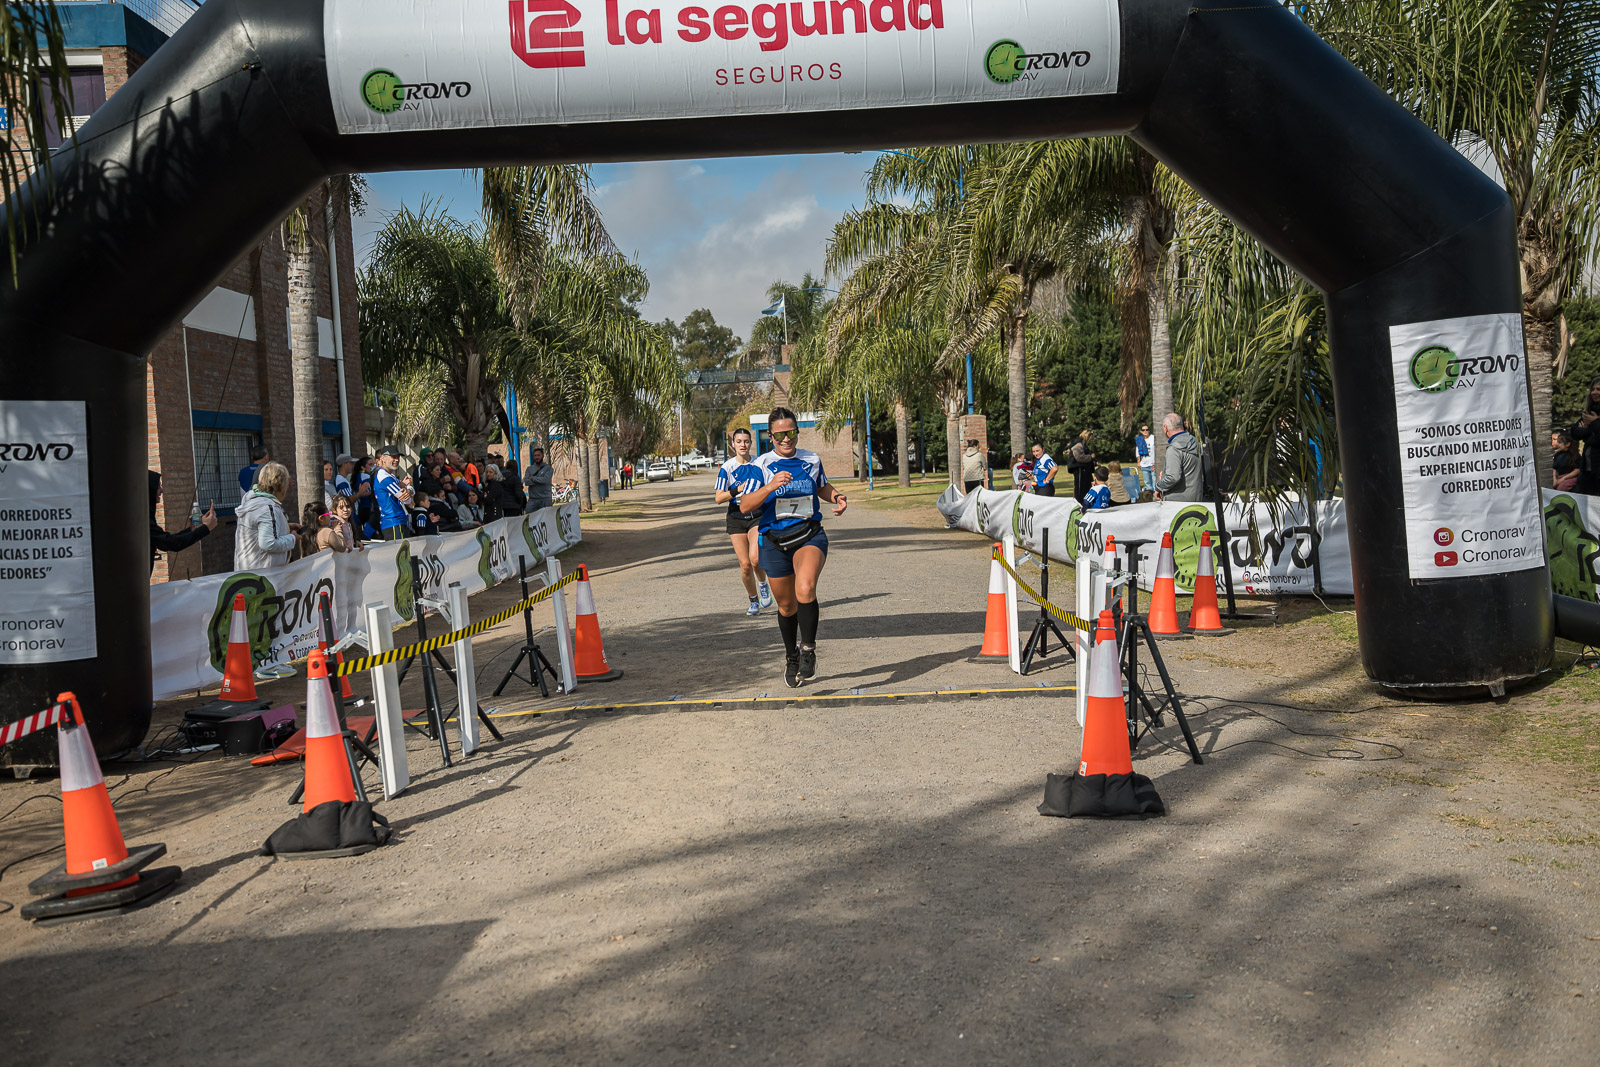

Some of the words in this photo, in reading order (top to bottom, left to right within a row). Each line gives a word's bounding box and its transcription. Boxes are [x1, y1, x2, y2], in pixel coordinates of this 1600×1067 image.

[605, 0, 662, 45] la
[677, 0, 945, 52] segunda
[1014, 50, 1091, 71] CRONO
[715, 62, 842, 86] SEGUROS
[1011, 72, 1039, 82] RAV
[392, 81, 471, 101] CRONO
[392, 102, 420, 111] RAV
[1445, 354, 1519, 377] CRONO
[1445, 378, 1476, 390] RAV
[1464, 418, 1522, 435] CORREDORES
[1407, 442, 1469, 459] BUSCANDO
[1472, 437, 1517, 453] MEJORAR
[1518, 436, 1529, 448] LAS
[1420, 458, 1498, 477] EXPERIENCIAS
[1500, 457, 1511, 469] DE
[1514, 455, 1525, 468] LOS
[790, 503, 799, 515] 7
[1, 528, 59, 541] MEJORAR
[62, 527, 83, 539] LAS
[1461, 526, 1526, 543] Cronorav
[32, 548, 48, 560] DE
[52, 546, 73, 559] LOS
[1462, 546, 1527, 563] Cronorav
[0, 619, 65, 631] ronorav
[0, 639, 66, 651] ronorav
